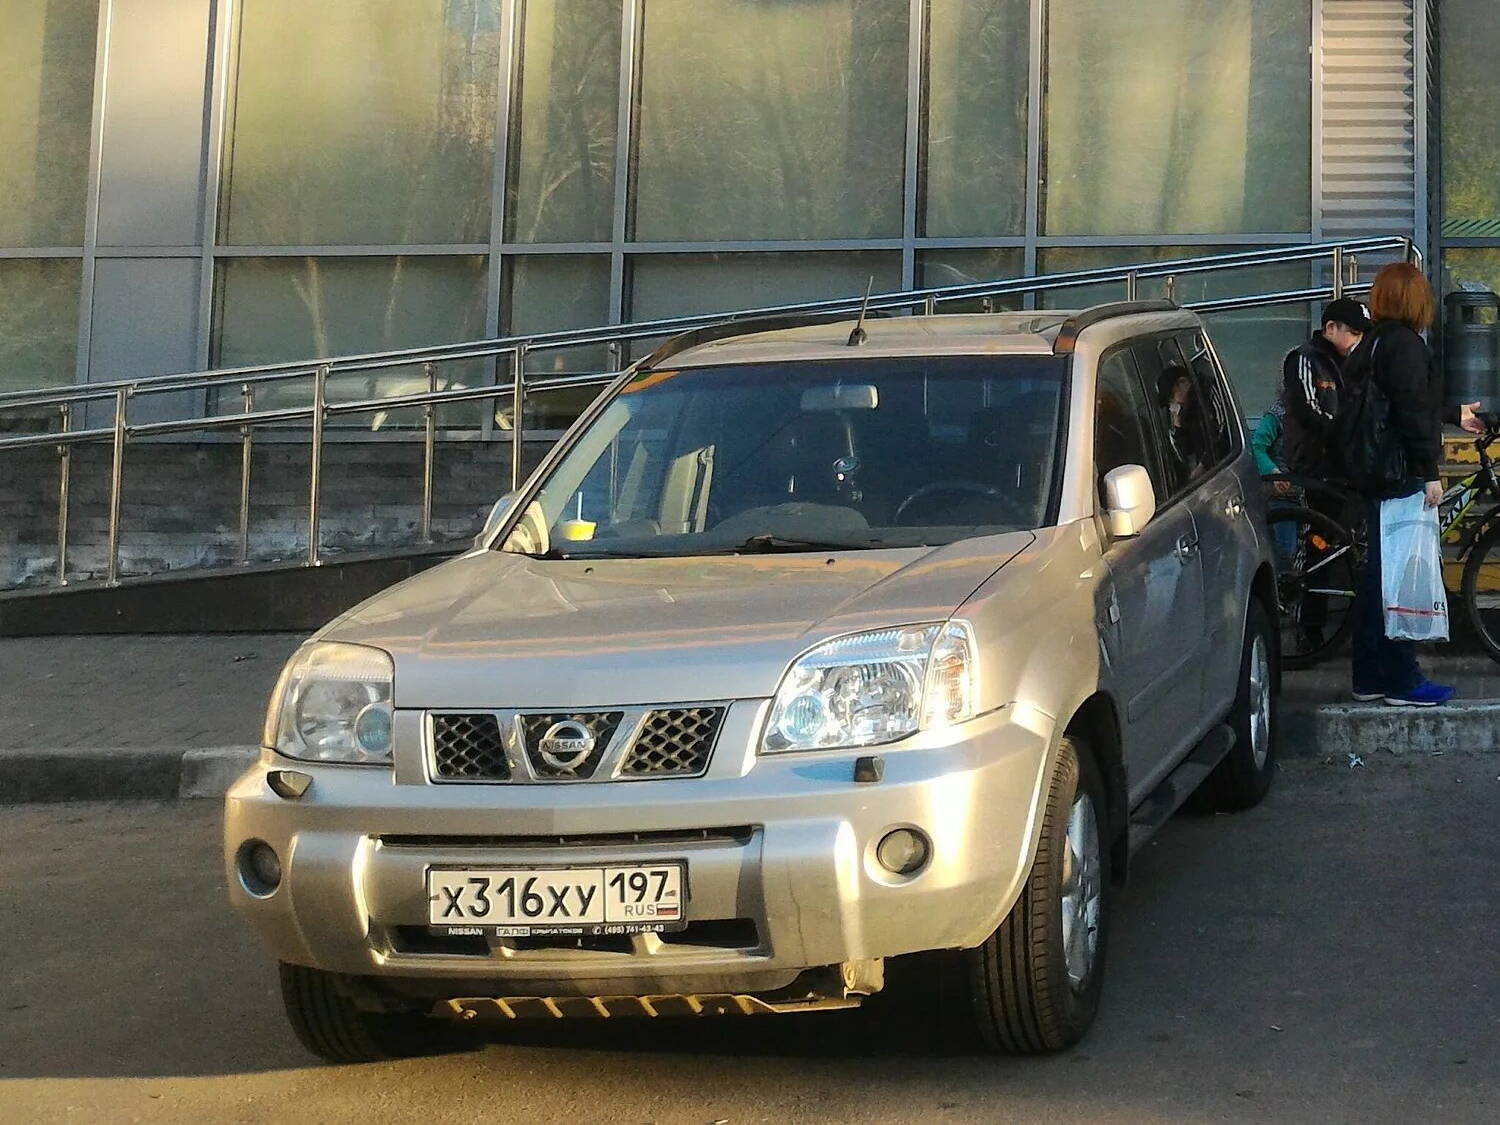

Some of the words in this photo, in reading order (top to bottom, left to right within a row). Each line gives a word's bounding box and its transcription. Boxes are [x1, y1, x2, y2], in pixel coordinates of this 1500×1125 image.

[542, 741, 586, 750] NISSAN
[609, 870, 670, 903] 197
[624, 904, 656, 916] RUS
[448, 927, 483, 936] NISSAN
